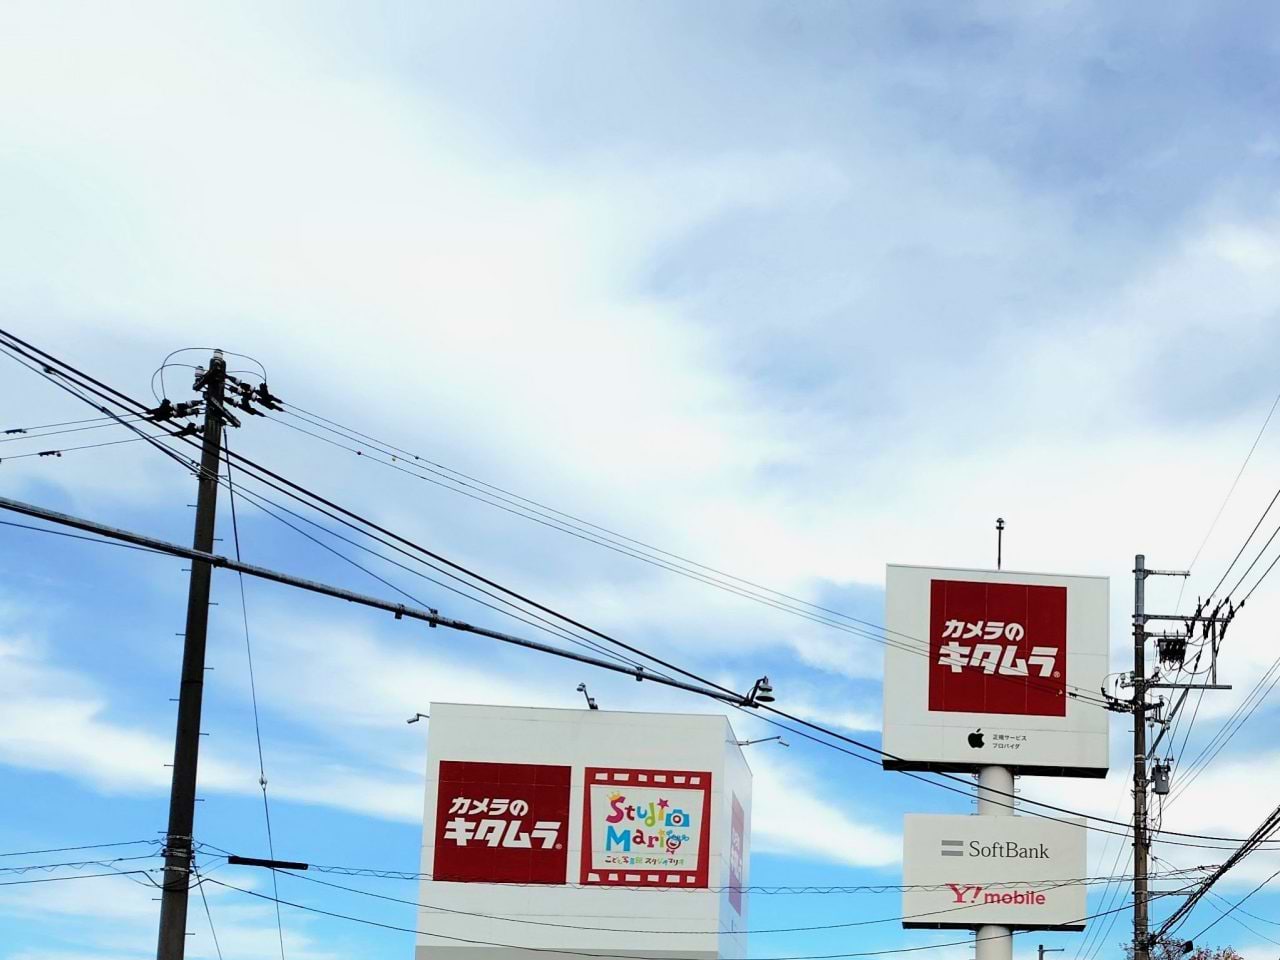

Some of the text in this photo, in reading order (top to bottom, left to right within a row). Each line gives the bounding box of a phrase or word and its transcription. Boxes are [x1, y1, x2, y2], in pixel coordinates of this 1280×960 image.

[942, 619, 1025, 641] カメラの
[937, 641, 1059, 677] キタムラ
[992, 733, 1027, 742] 正規サービス
[448, 797, 529, 817] カメラの
[443, 816, 562, 850] キタムラ
[605, 825, 682, 852] Mario
[968, 840, 1050, 859] SoftBank
